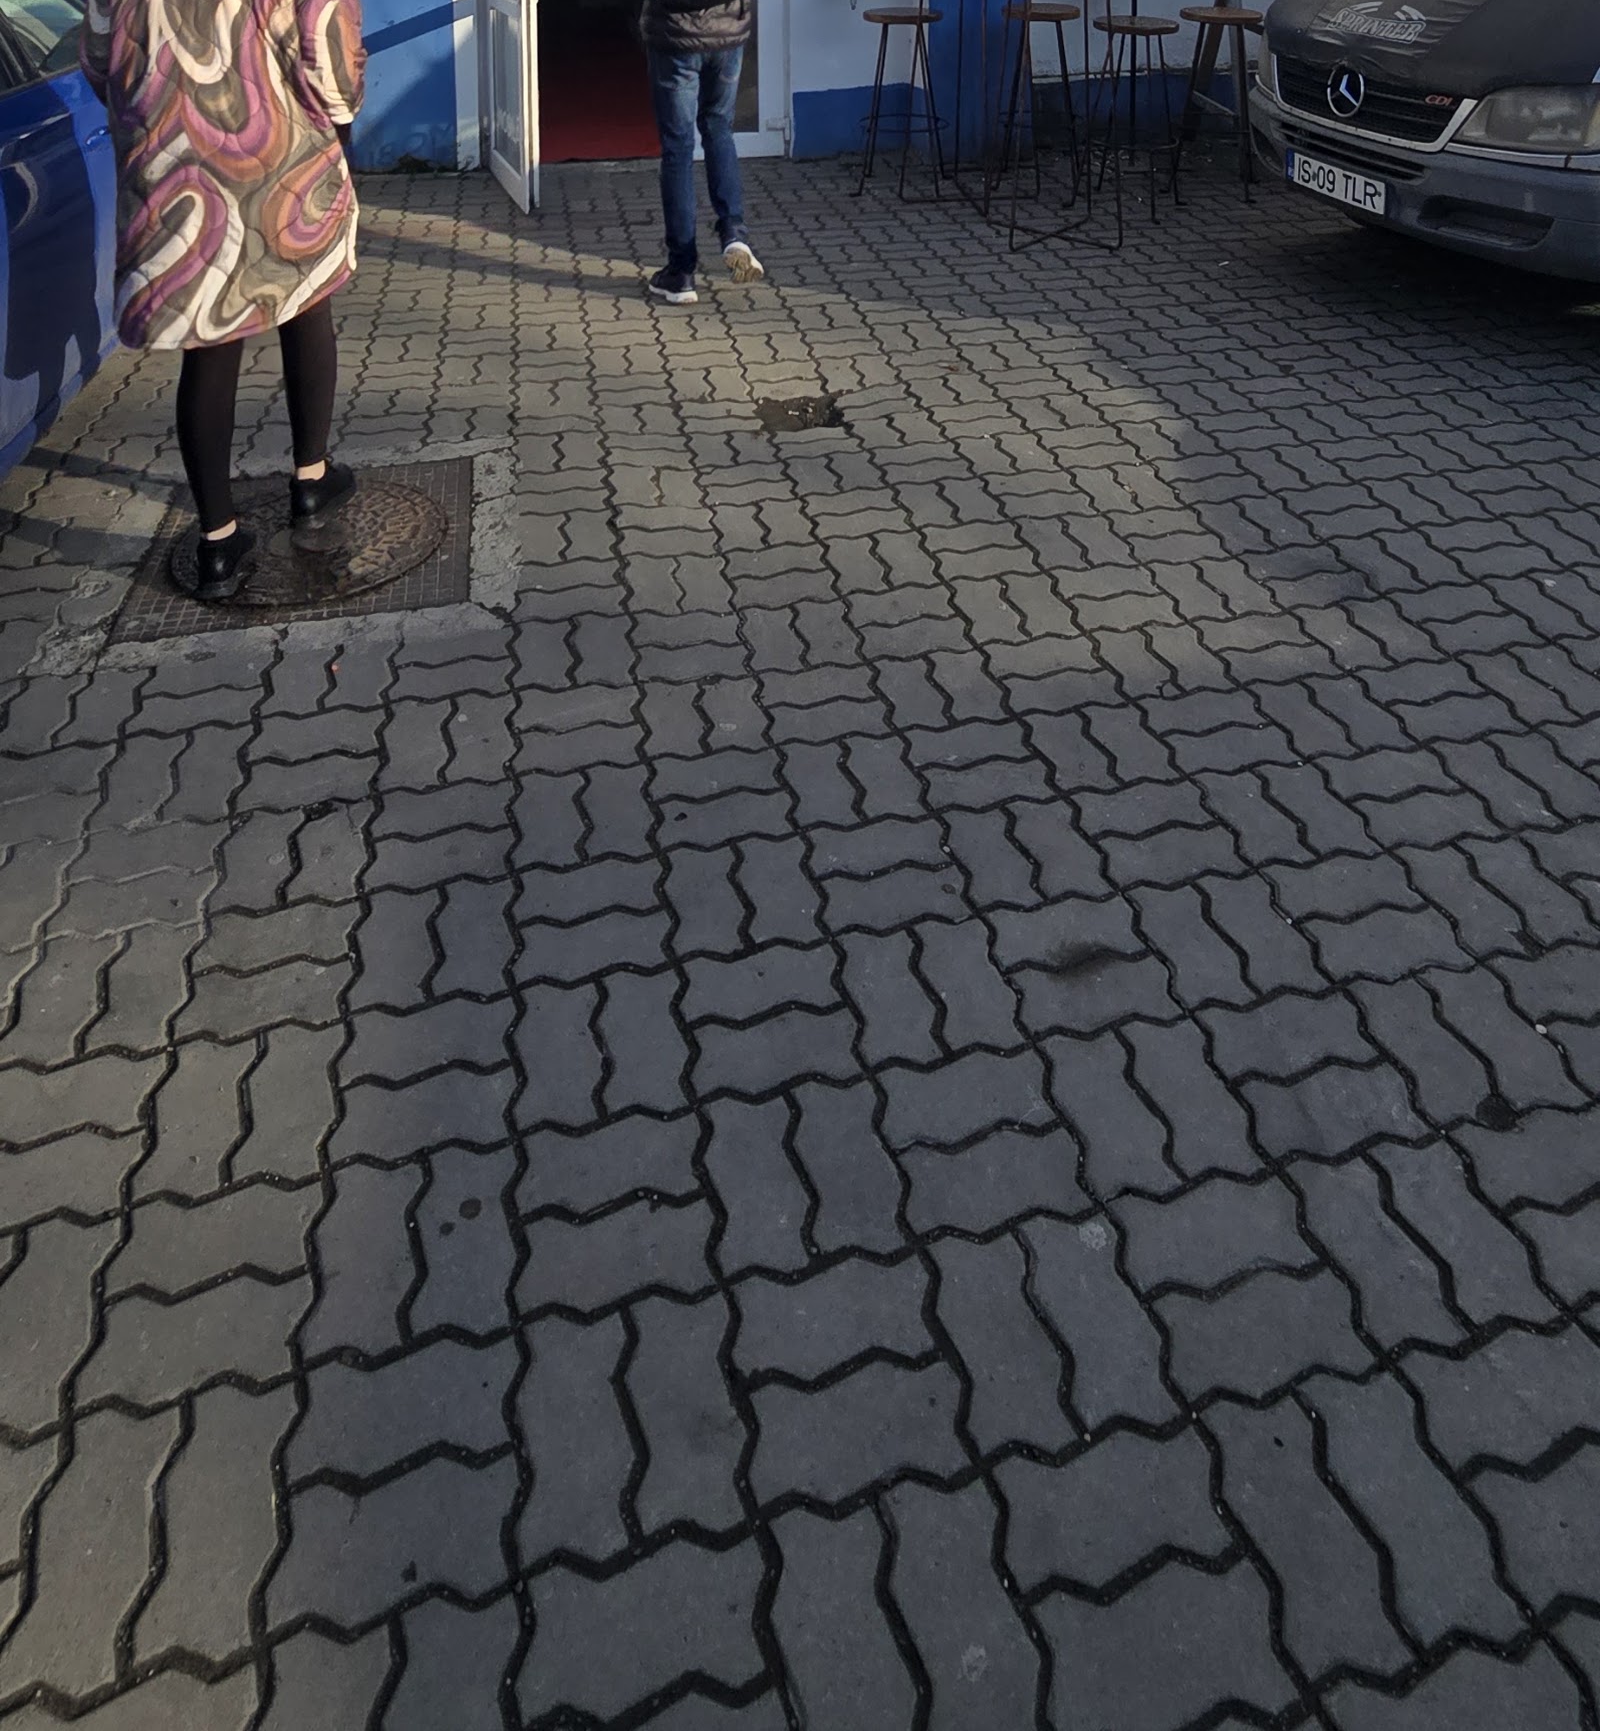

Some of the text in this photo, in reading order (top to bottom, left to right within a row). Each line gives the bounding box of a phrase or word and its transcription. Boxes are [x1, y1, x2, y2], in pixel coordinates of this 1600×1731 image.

[1328, 10, 1422, 41] SPRINTER
[1425, 94, 1453, 106] CDI
[1297, 157, 1377, 210] IS 09 TLR
